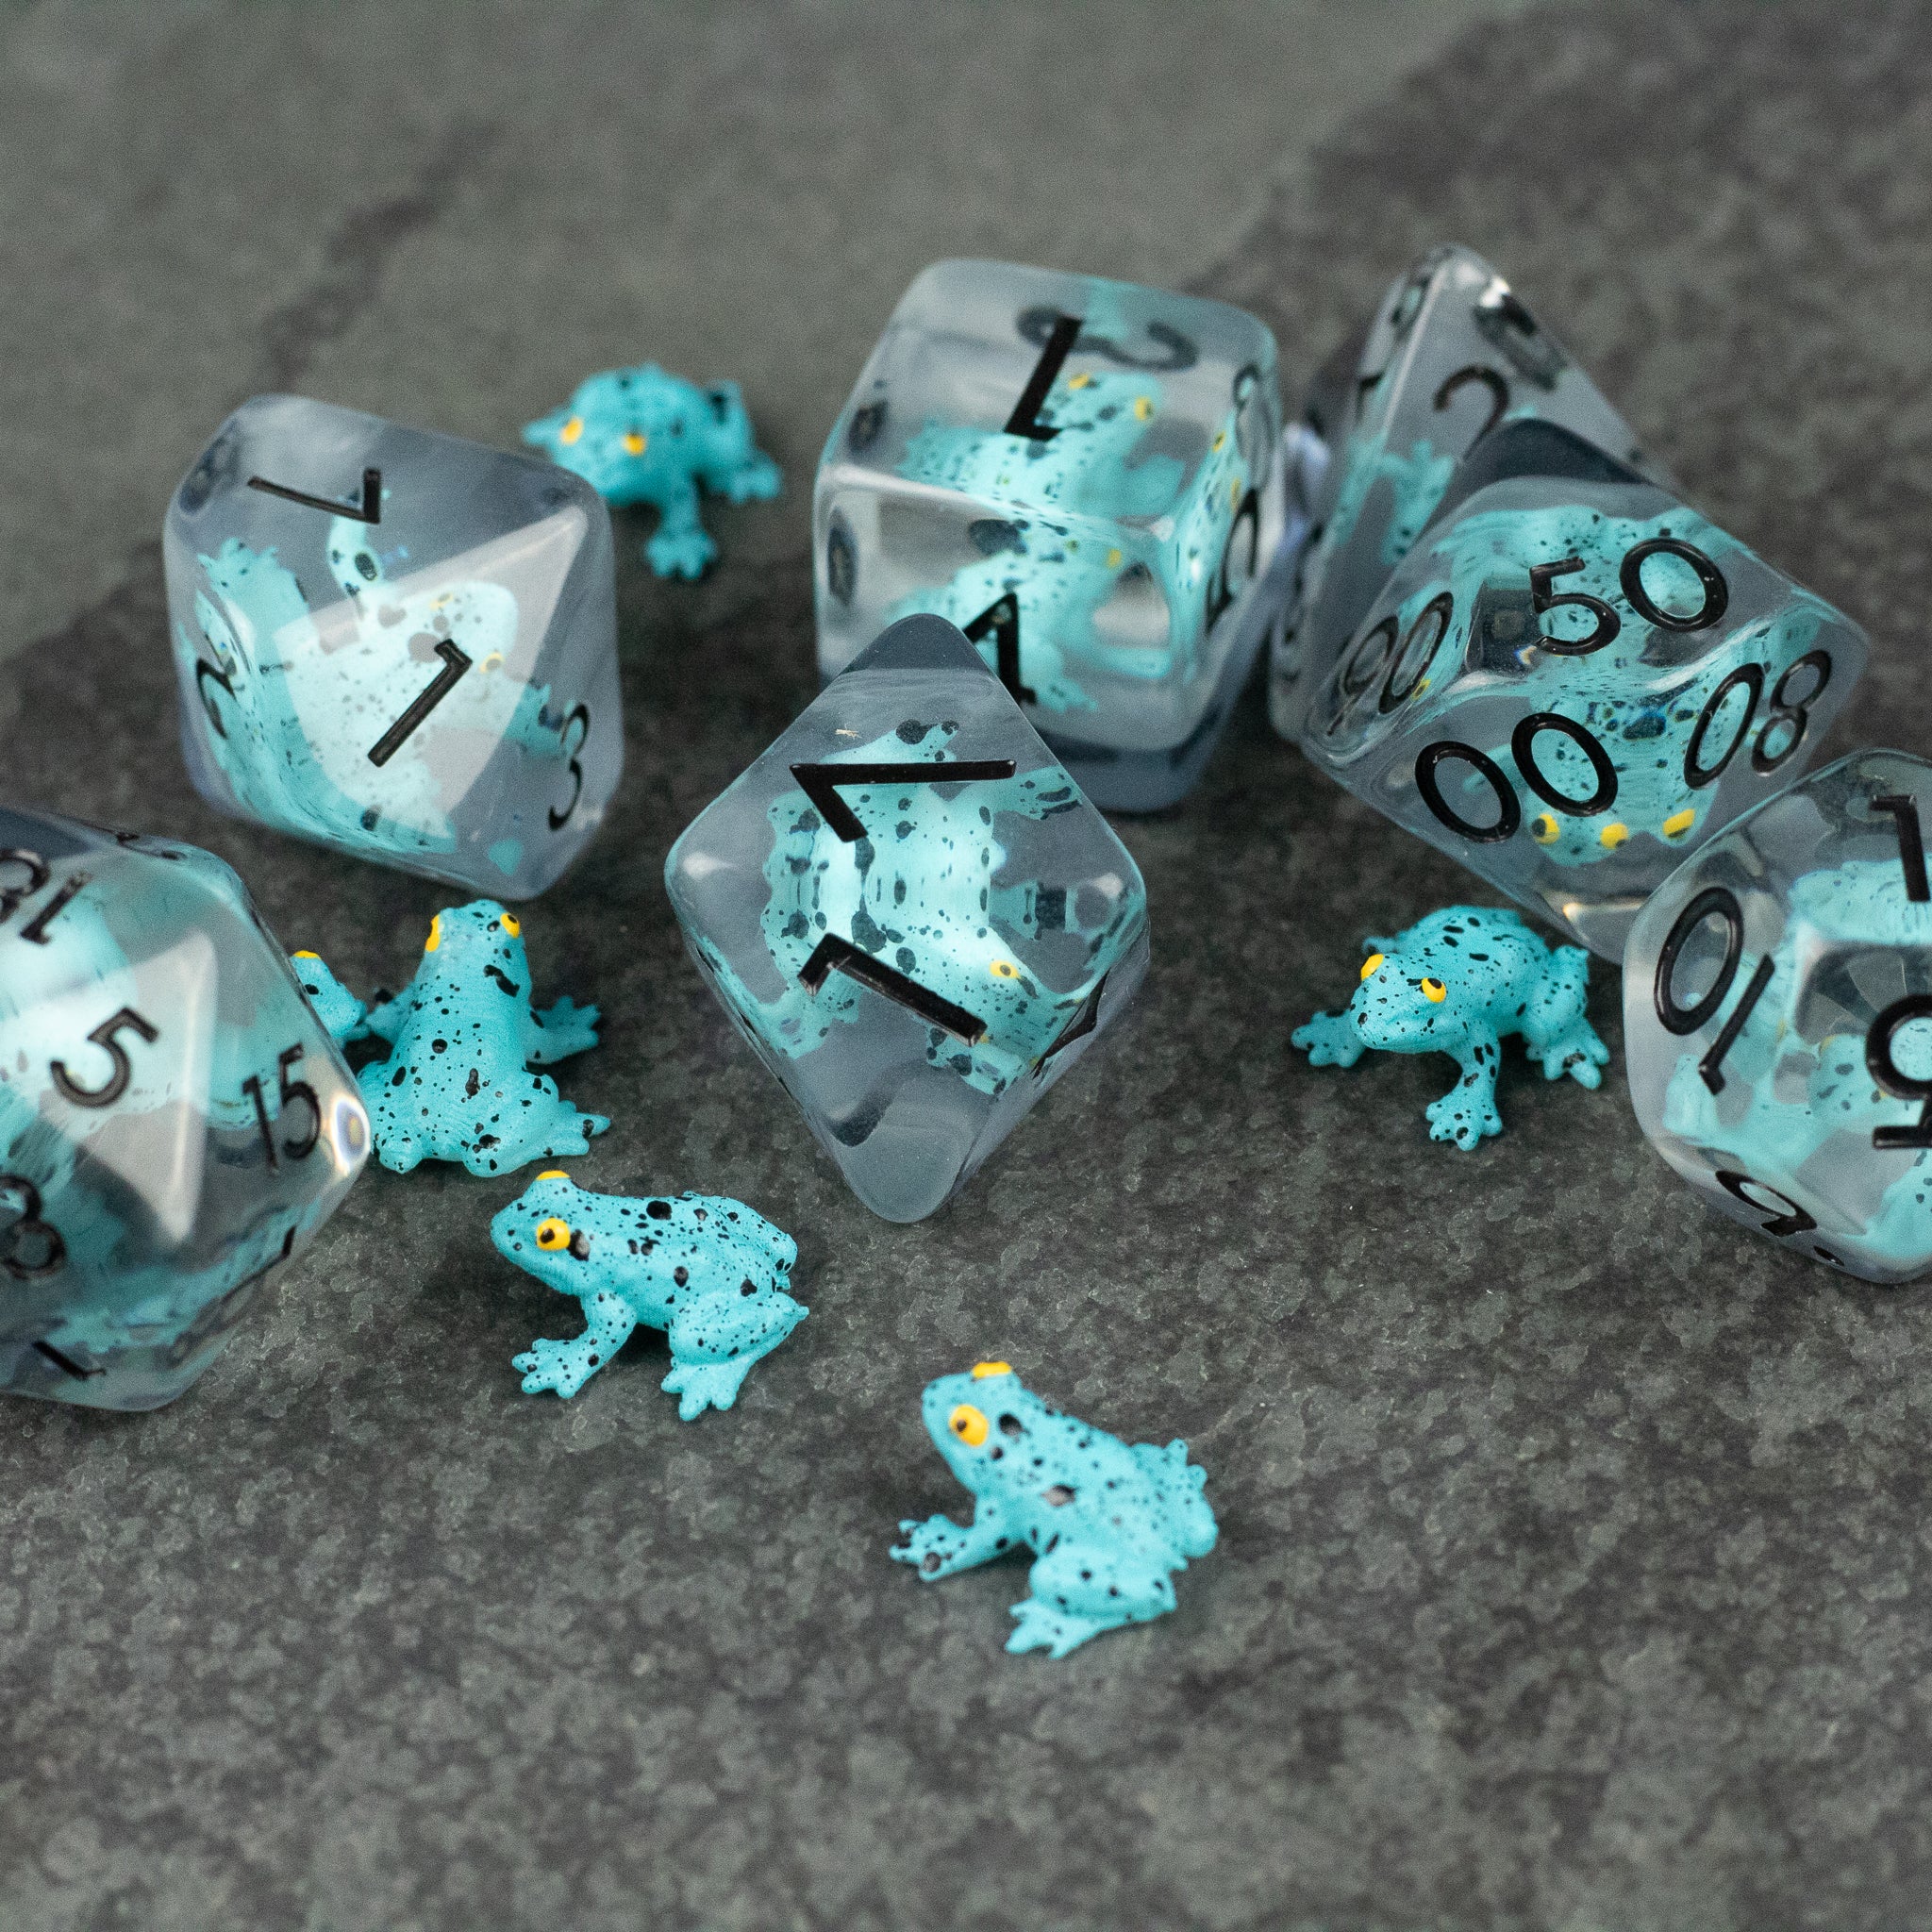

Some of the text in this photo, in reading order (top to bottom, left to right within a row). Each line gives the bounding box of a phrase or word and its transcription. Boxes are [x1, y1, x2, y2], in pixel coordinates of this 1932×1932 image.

[1527, 537, 1729, 657] 50
[367, 638, 473, 768] 1
[548, 703, 591, 831] 3
[1414, 712, 1618, 842] 00
[50, 1007, 158, 1108] 5
[242, 1041, 322, 1172] 15
